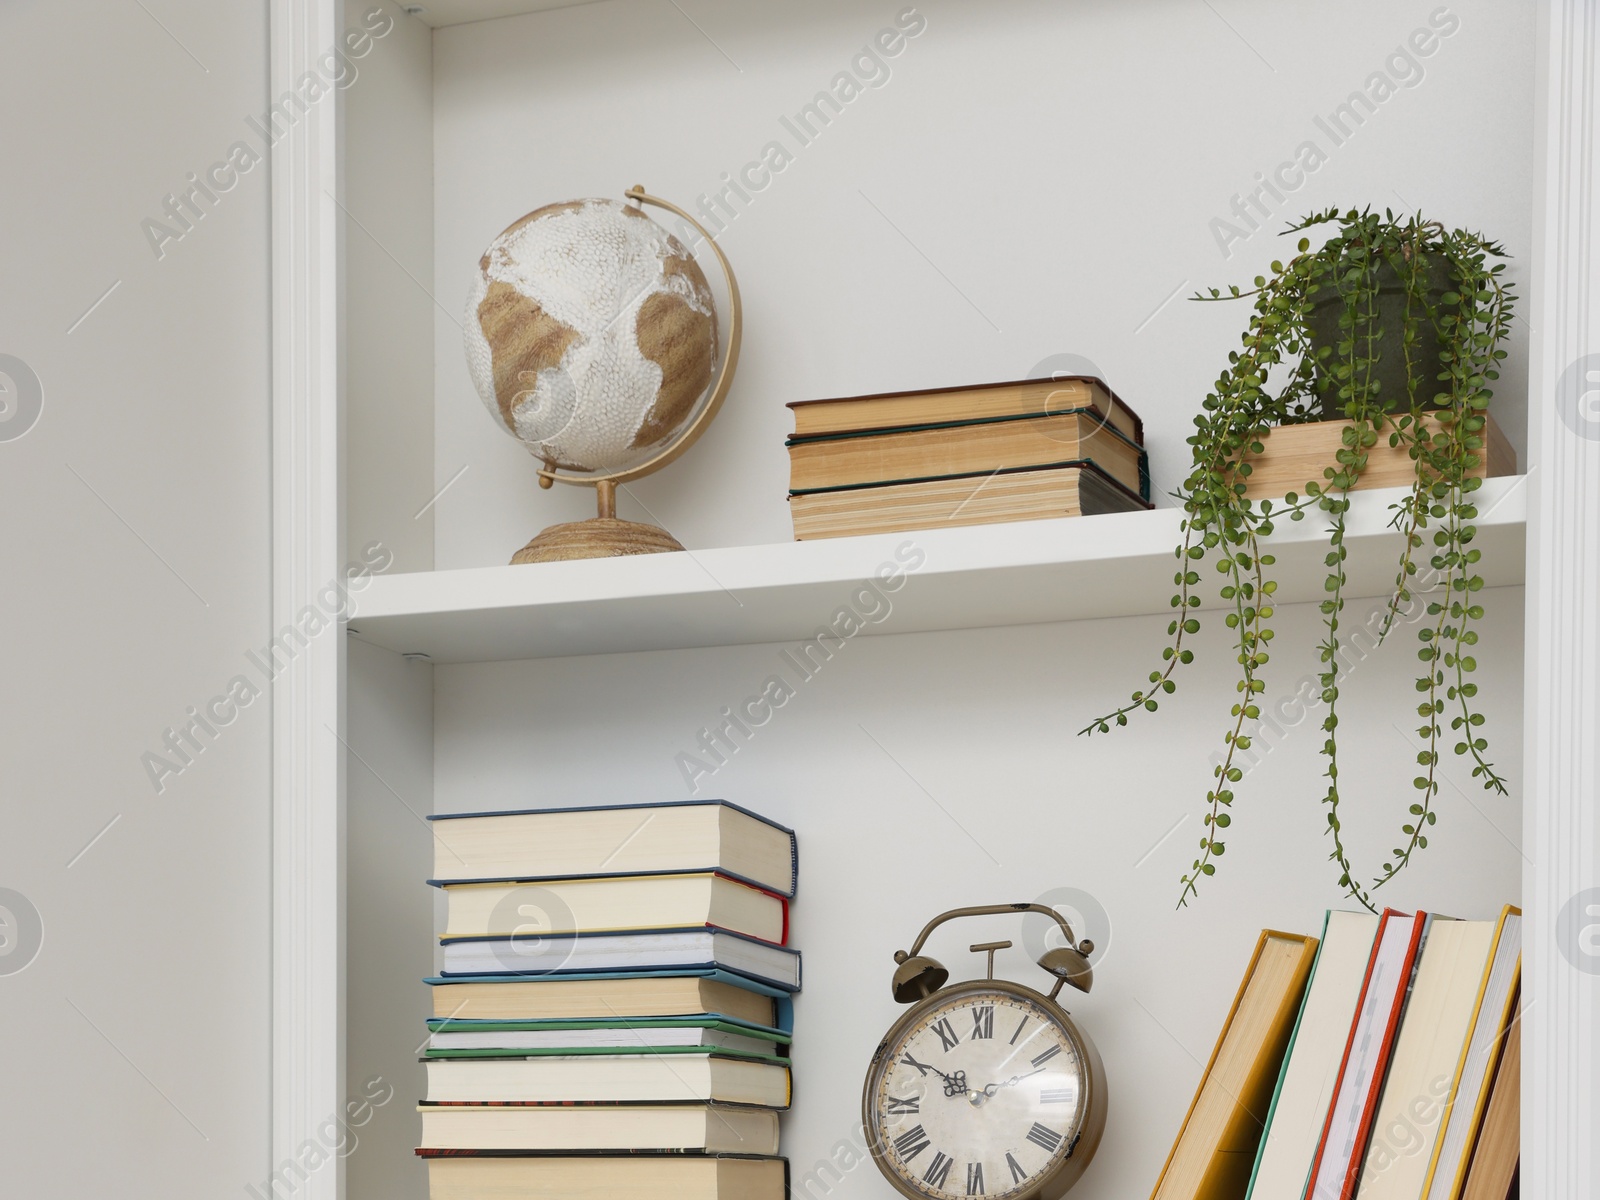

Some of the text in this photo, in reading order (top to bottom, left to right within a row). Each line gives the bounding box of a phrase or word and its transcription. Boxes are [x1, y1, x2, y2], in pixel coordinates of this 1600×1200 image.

[930, 1017, 960, 1053] XI
[971, 1006, 994, 1040] XII
[901, 1052, 931, 1077] X
[888, 1096, 920, 1114] IX
[922, 1151, 953, 1190] VII
[1005, 1152, 1028, 1185] V
